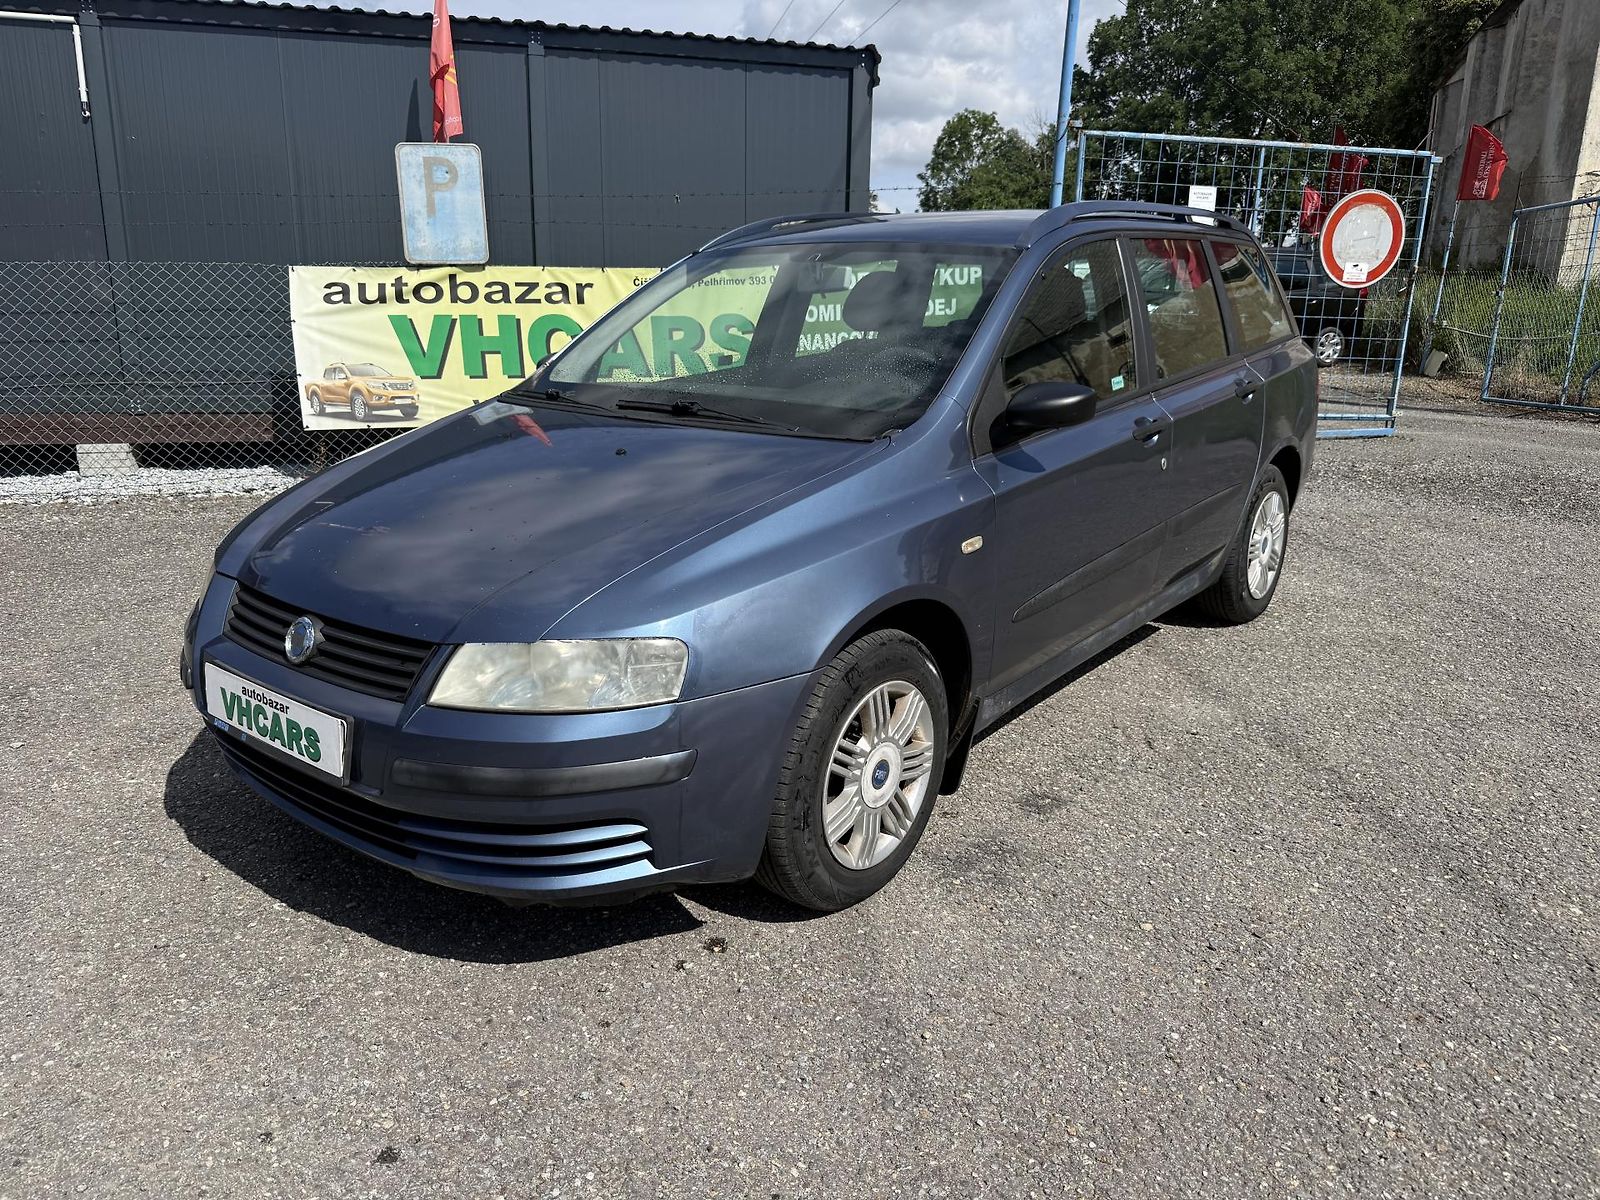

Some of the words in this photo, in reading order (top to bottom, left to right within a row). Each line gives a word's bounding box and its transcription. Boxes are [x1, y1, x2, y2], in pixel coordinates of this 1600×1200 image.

[422, 156, 459, 218] P
[322, 273, 594, 305] autobazar
[748, 275, 766, 285] 393
[933, 267, 982, 286] KUP
[806, 304, 843, 323] OMI
[925, 298, 957, 316] DEJ
[241, 685, 290, 715] autobazar
[220, 686, 322, 763] VHCARS
